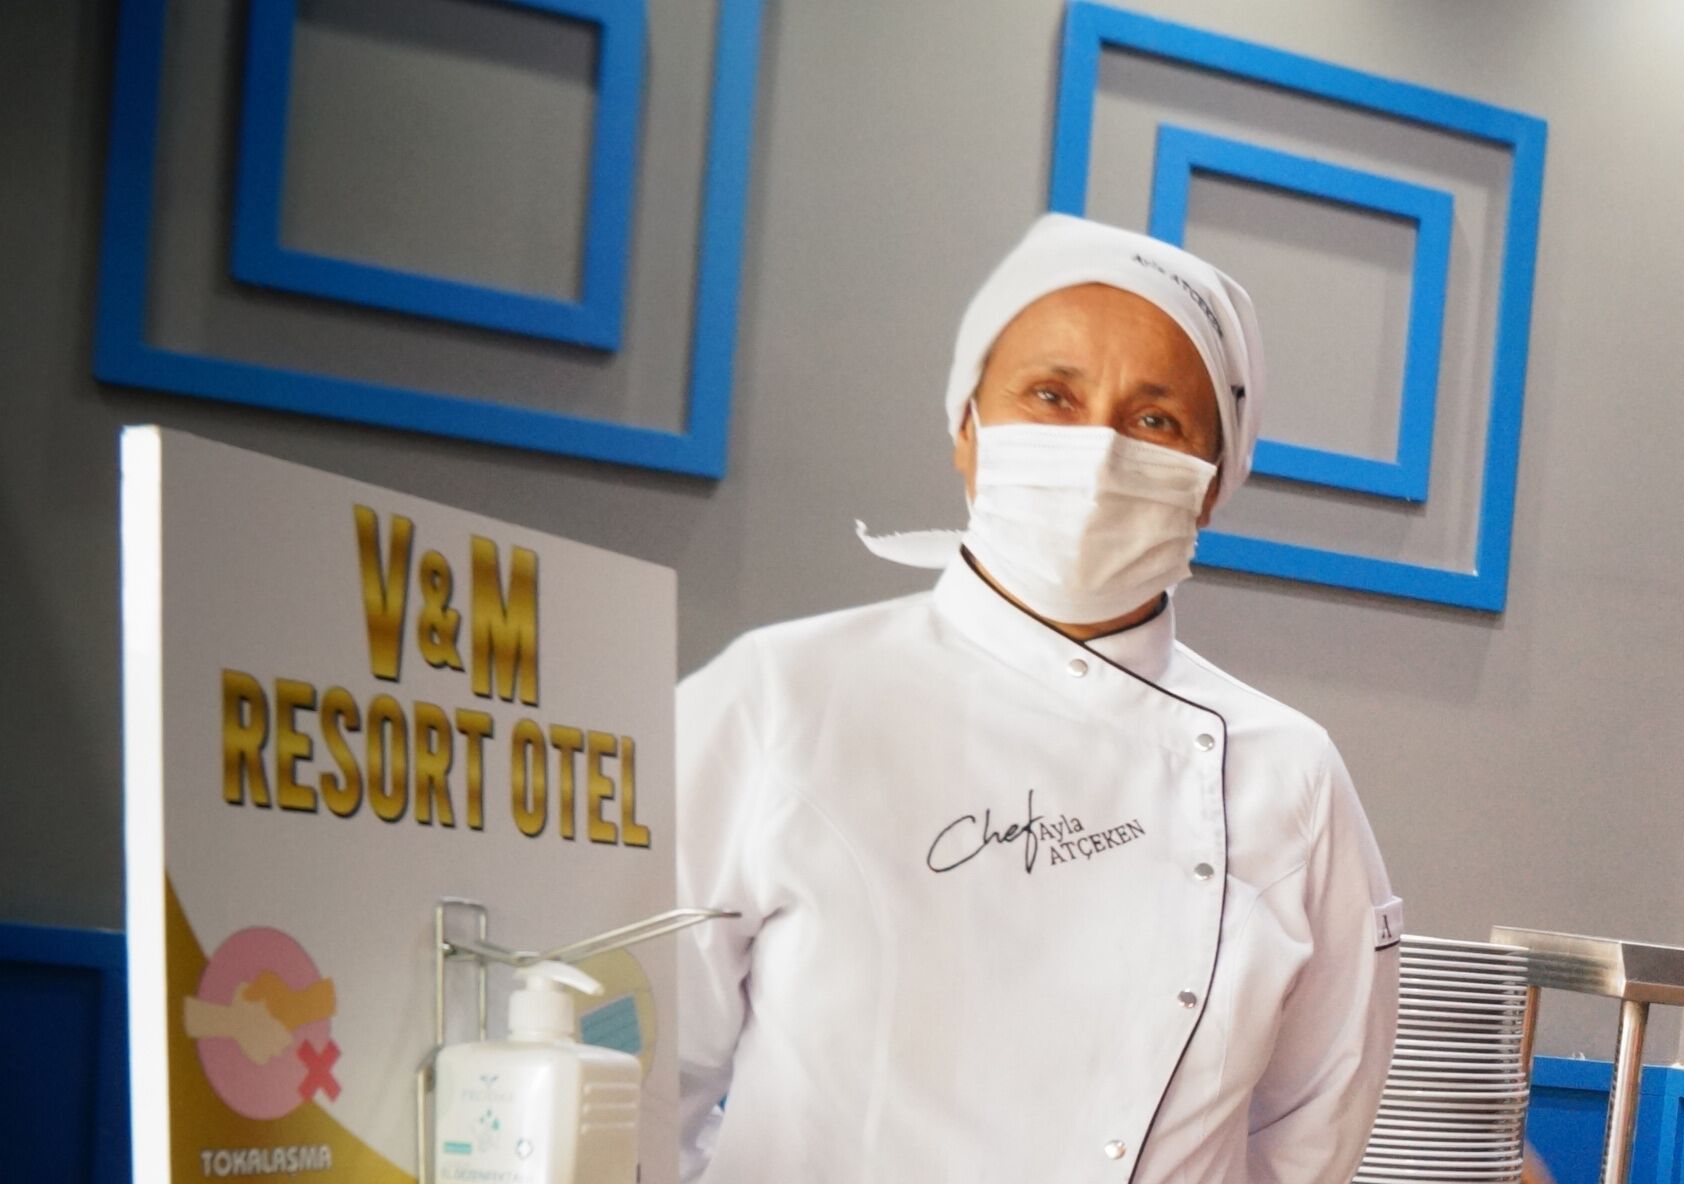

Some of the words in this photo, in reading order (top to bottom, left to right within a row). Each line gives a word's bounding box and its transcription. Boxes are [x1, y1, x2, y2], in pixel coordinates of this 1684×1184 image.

[353, 503, 539, 707] V&M
[221, 667, 495, 832] RESORT
[510, 717, 651, 849] OTEL
[926, 788, 1044, 874] Chef
[1039, 813, 1085, 843] Ayla
[1049, 818, 1147, 866] ATÇEKEN
[200, 1144, 333, 1177] TOKALAŞMA
